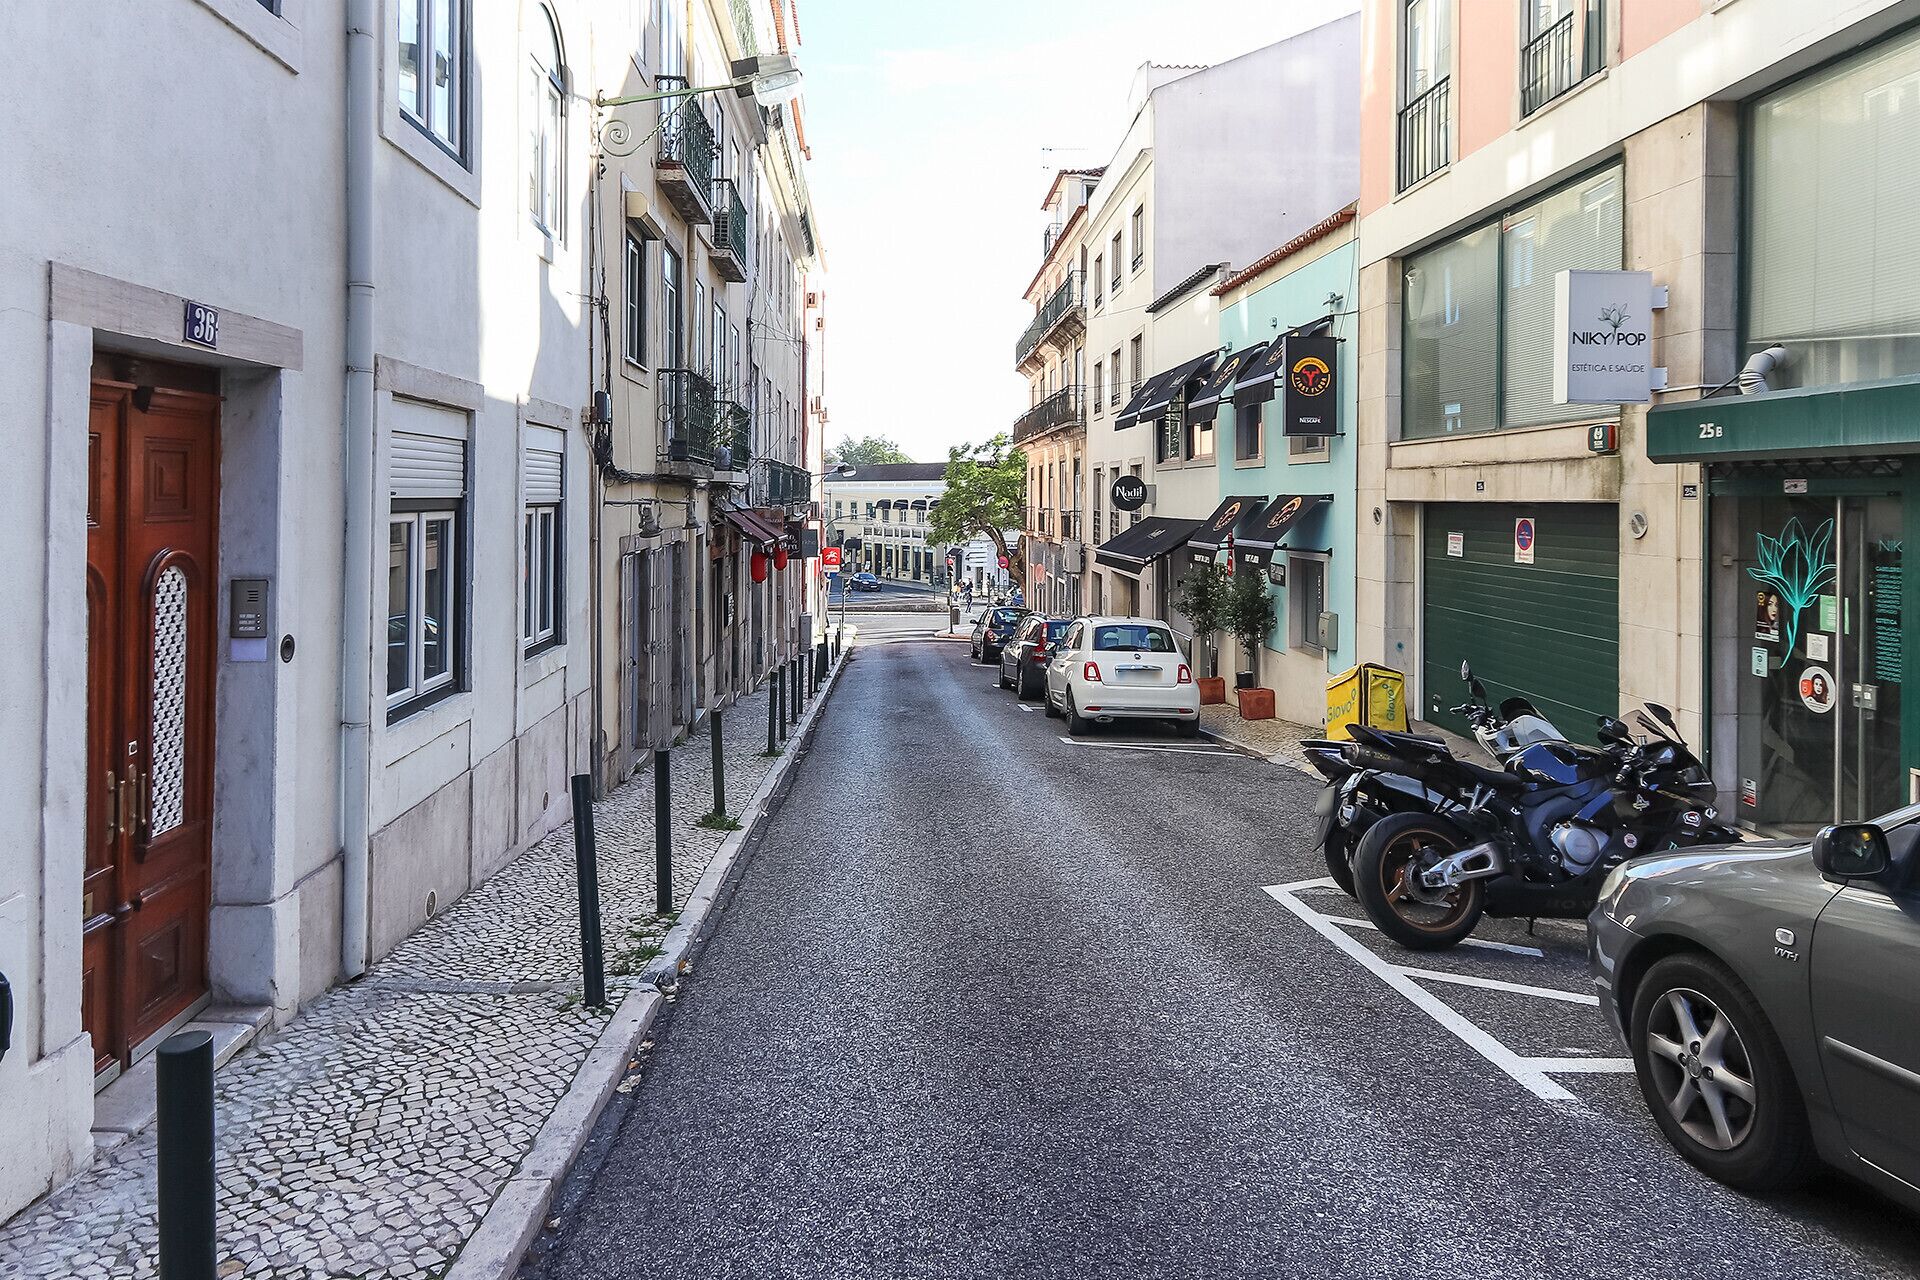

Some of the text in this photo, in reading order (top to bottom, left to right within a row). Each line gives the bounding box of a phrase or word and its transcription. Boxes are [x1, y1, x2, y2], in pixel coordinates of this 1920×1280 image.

[193, 307, 215, 342] 36
[1572, 331, 1647, 346] NIKY POP
[1571, 363, 1645, 373] ESTÉTICA E SAÚDE
